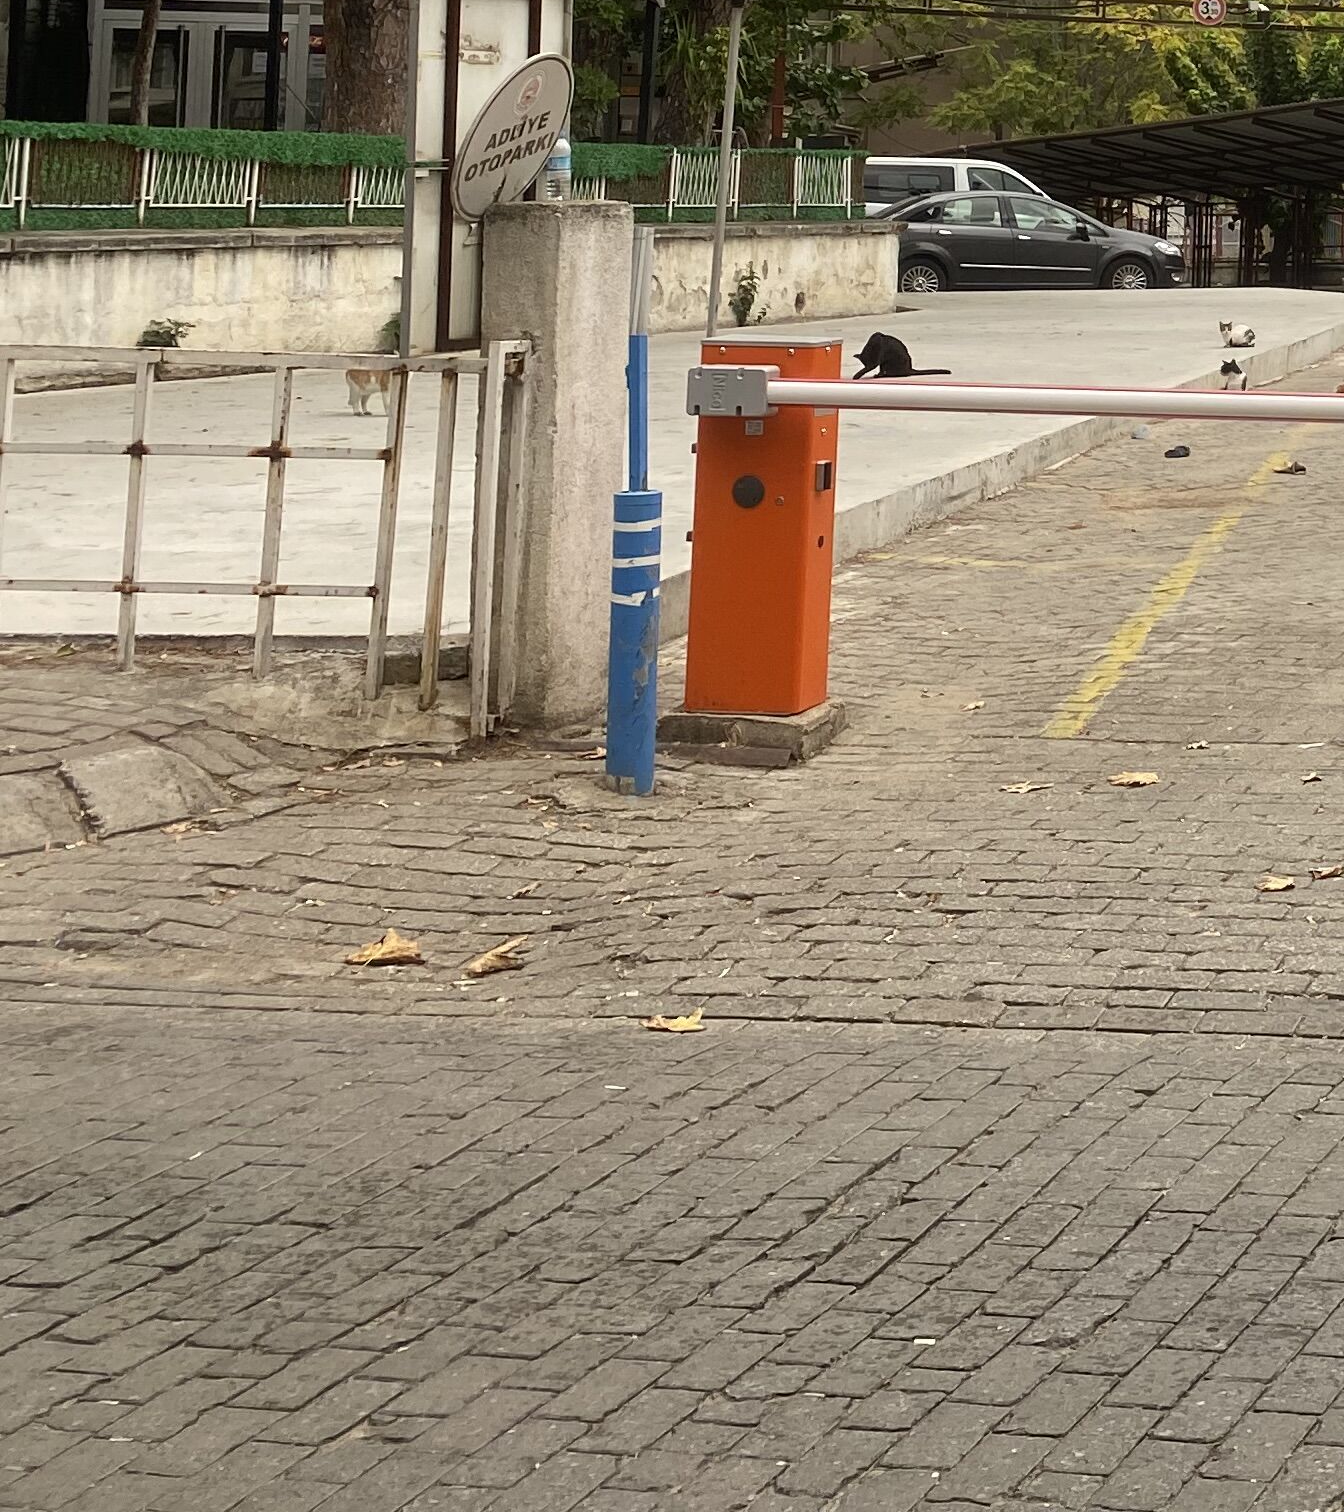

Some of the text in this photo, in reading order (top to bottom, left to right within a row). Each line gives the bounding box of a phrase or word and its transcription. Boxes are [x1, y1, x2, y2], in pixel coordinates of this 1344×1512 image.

[1201, 1, 1210, 15] 3
[483, 110, 551, 153] ADLİYE
[464, 131, 555, 182] OTOPARKI
